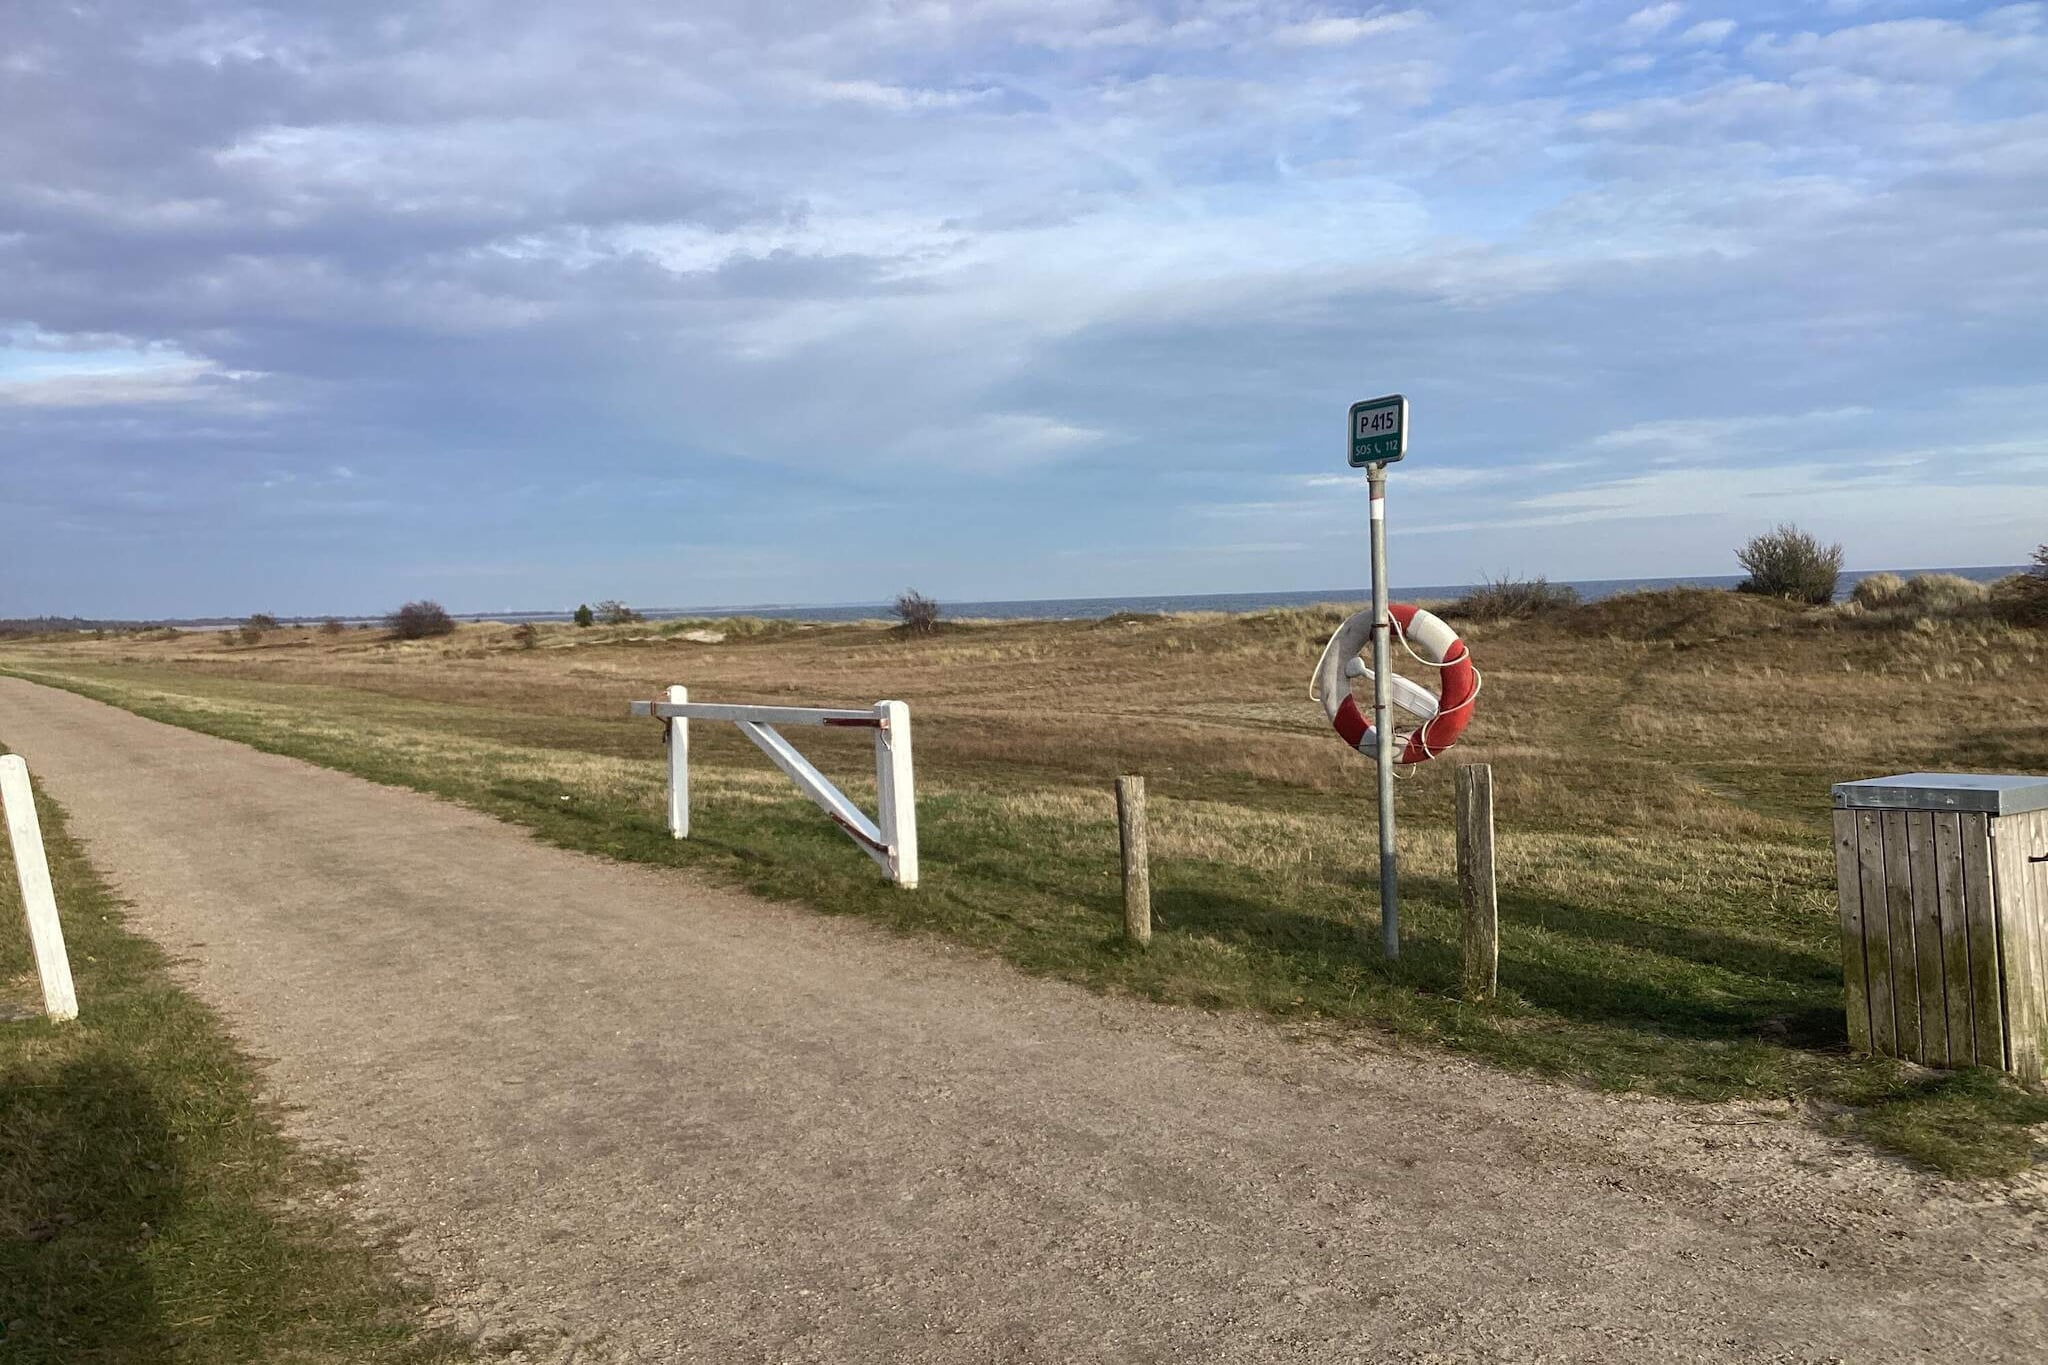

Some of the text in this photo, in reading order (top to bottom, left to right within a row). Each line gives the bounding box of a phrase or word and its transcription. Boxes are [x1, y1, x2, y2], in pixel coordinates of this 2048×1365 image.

[1360, 411, 1394, 433] P 415
[1355, 439, 1398, 456] SOS 112
